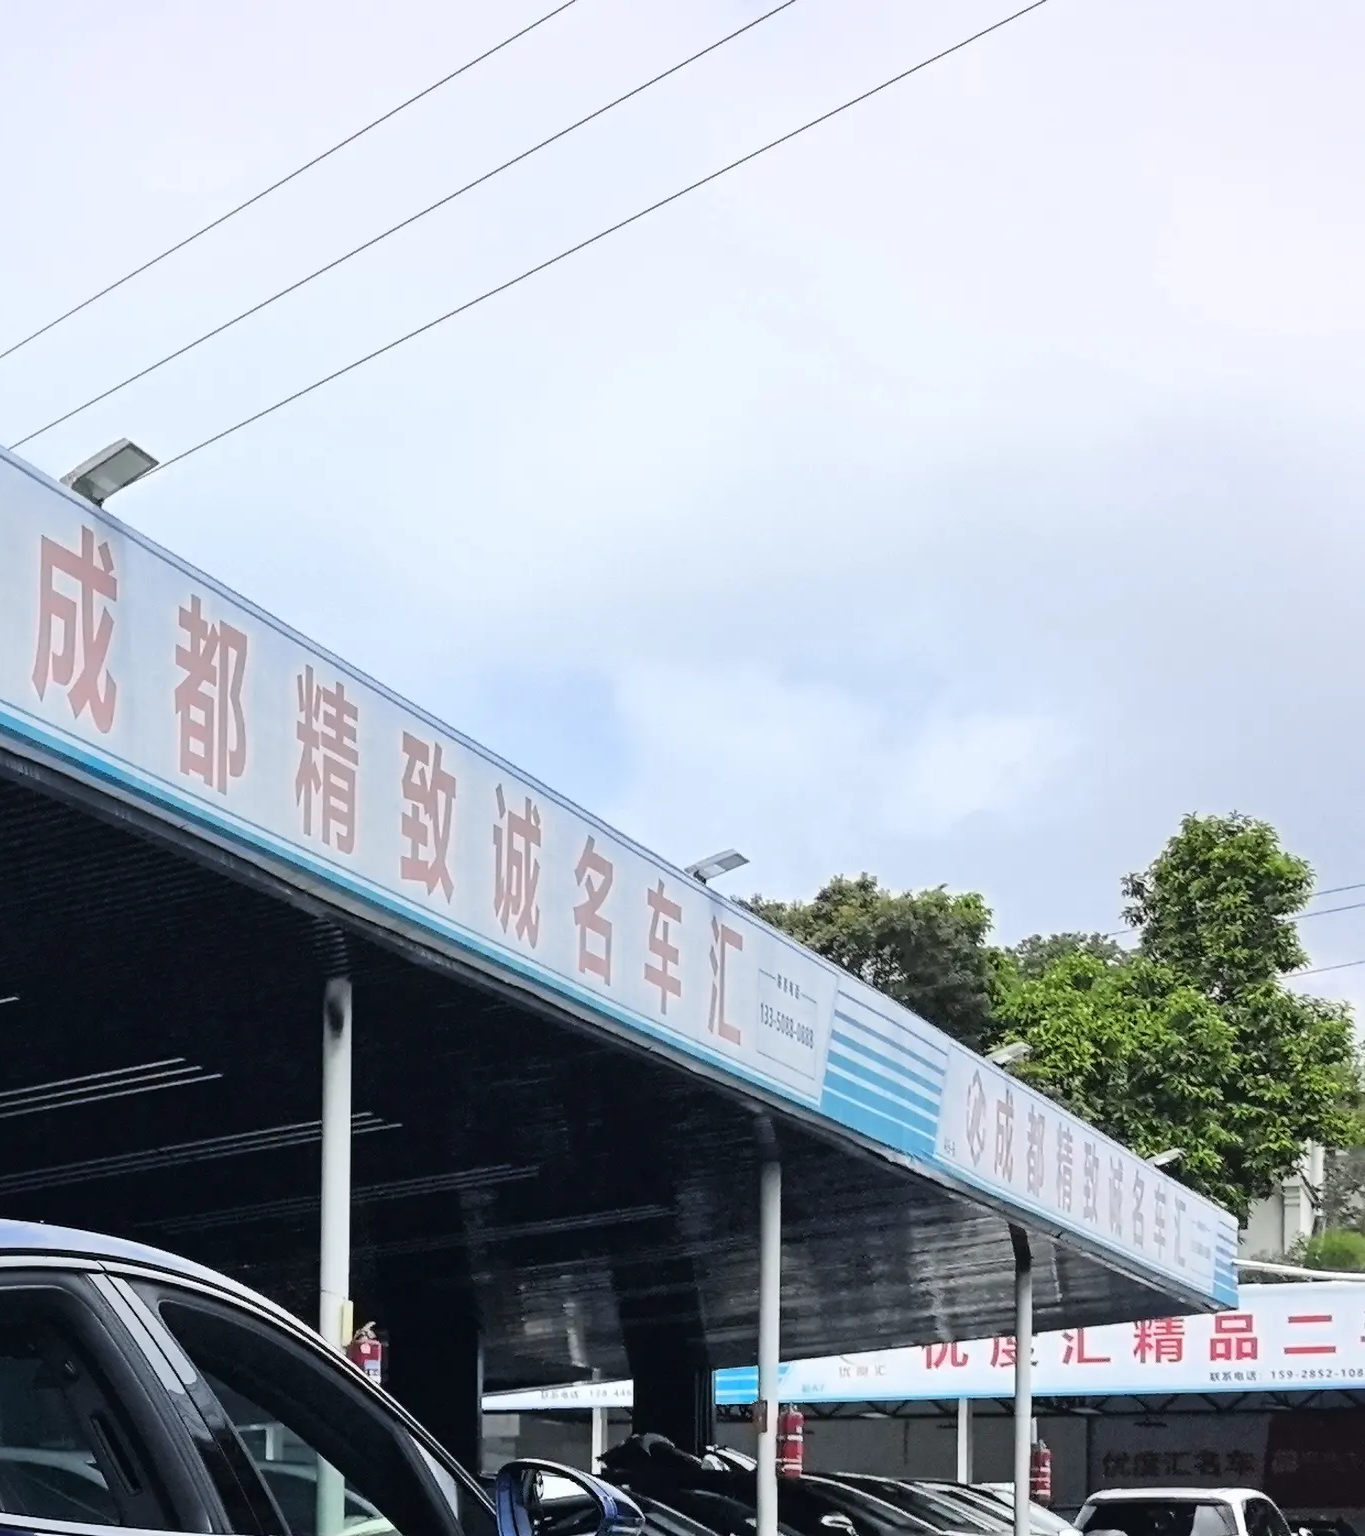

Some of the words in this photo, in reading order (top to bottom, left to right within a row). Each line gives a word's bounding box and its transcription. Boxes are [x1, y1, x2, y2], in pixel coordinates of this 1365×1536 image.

[31, 524, 743, 1045] 成都精致诚名车汇
[922, 1314, 1365, 1369] 优汇精品二
